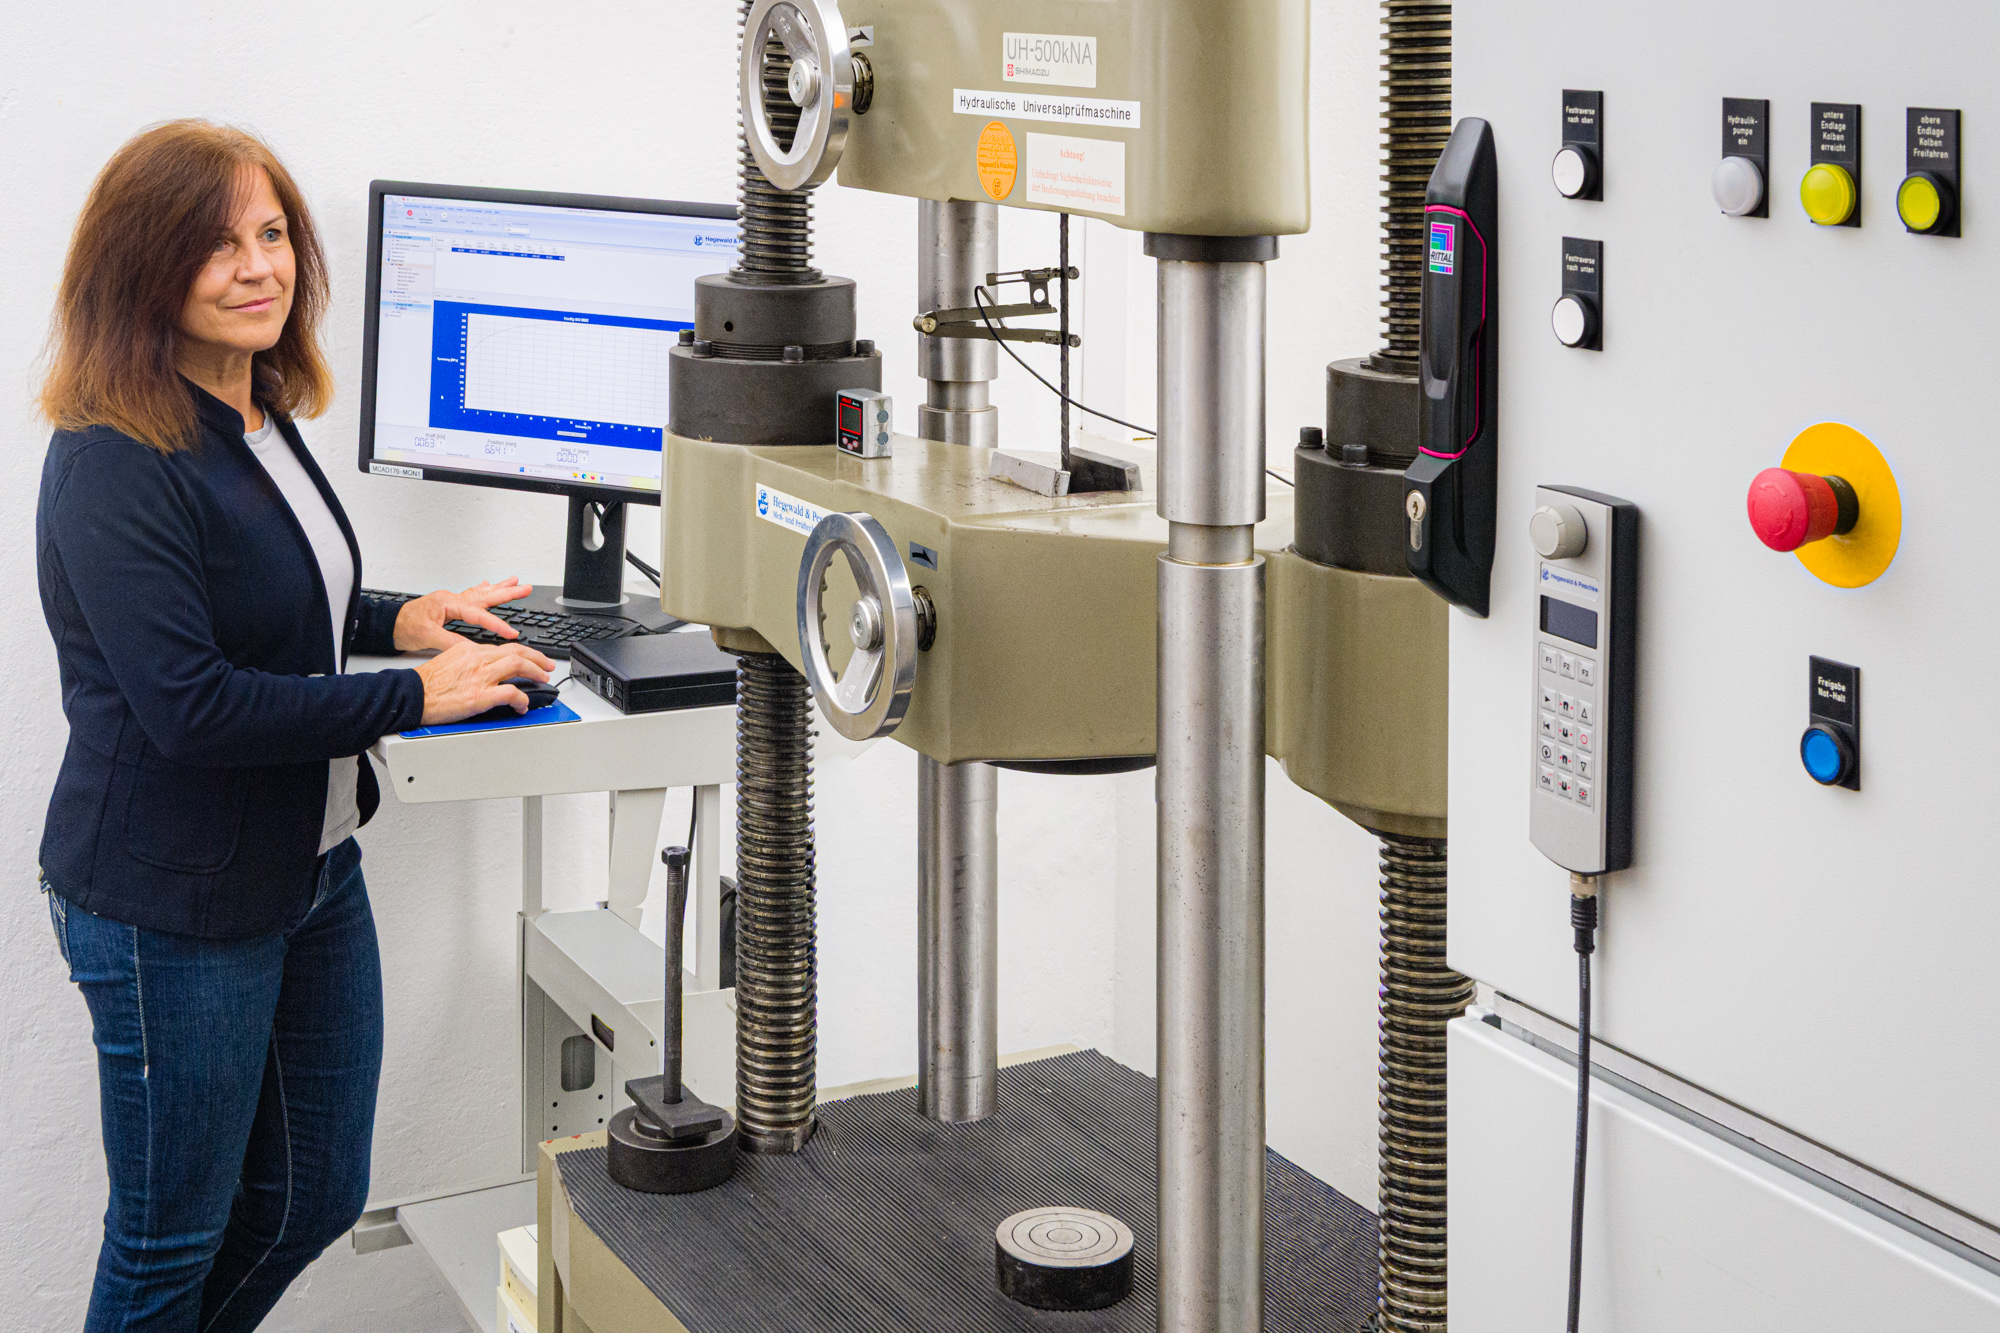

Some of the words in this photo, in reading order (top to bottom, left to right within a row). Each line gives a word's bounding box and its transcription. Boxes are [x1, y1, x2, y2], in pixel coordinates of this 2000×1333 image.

[1006, 38, 1092, 65] UH-500kNA
[1015, 67, 1050, 76] SHIMADZU
[960, 95, 1016, 110] Hydraulische
[1023, 100, 1131, 120] Universalprüfmaschine
[1566, 106, 1596, 115] Festtraverse
[1728, 115, 1758, 125] Hydraulik-
[1822, 111, 1844, 120] untere
[1920, 115, 1940, 124] obere
[1821, 120, 1846, 132] Endlage
[1732, 128, 1753, 136] pumpe
[1822, 132, 1844, 140] Kolben
[1917, 126, 1944, 138] Endlage
[1738, 137, 1748, 145] ein
[1919, 138, 1942, 146] Kolben
[1821, 144, 1846, 152] erreicht
[1913, 148, 1949, 158] Freifahren
[1059, 149, 1085, 162] Achtung!
[1032, 168, 1058, 183] Unbedingt
[1060, 173, 1112, 188] Sicherheitshinweise
[1032, 184, 1040, 192] der
[1041, 184, 1096, 202] Bedienungsanleitung
[1096, 191, 1121, 204] beachten
[1430, 251, 1452, 262] RITTAL
[1566, 254, 1596, 264] Festtraverse
[372, 466, 420, 476] MCAD176-MON1
[773, 496, 804, 516] Hegewald
[804, 508, 810, 520] &
[812, 510, 824, 522] Pes
[785, 516, 794, 526] und
[1550, 573, 1574, 585] Hegewald
[1578, 581, 1598, 592] Peschke
[1546, 656, 1552, 664] F1
[1564, 662, 1570, 670] F2
[1582, 668, 1588, 677] F3
[1818, 676, 1846, 692] Freigabe
[1818, 687, 1846, 702] Not-Halt
[1542, 776, 1550, 785] ON
